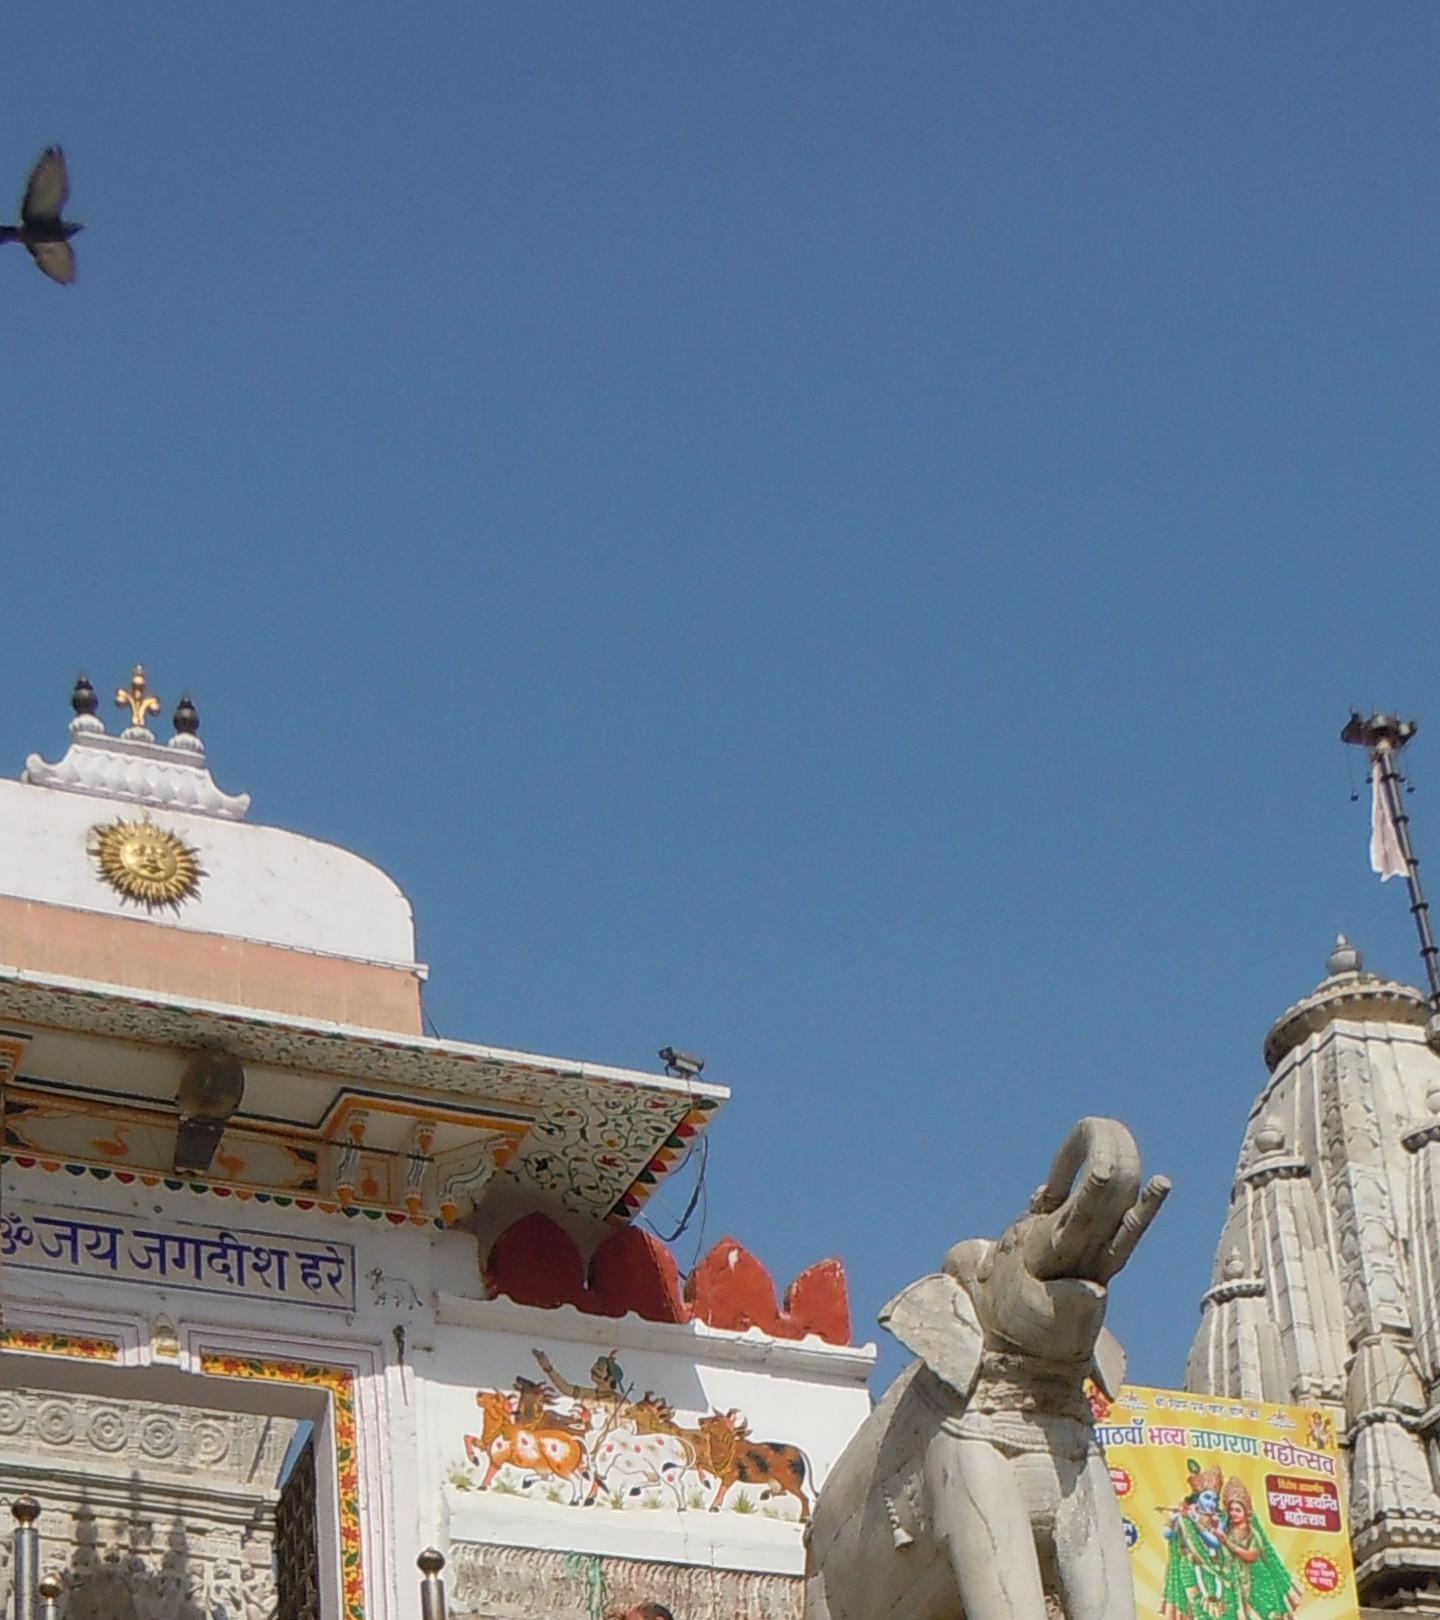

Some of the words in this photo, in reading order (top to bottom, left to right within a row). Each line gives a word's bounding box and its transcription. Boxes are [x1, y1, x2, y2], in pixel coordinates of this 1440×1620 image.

[33, 1216, 124, 1270] जय
[128, 1231, 289, 1291] जगदीश
[296, 1246, 345, 1298] हरे
[1148, 1427, 1186, 1447] भव्य
[1189, 1429, 1258, 1456] जागरण
[1262, 1437, 1335, 1476] महोत्सव
